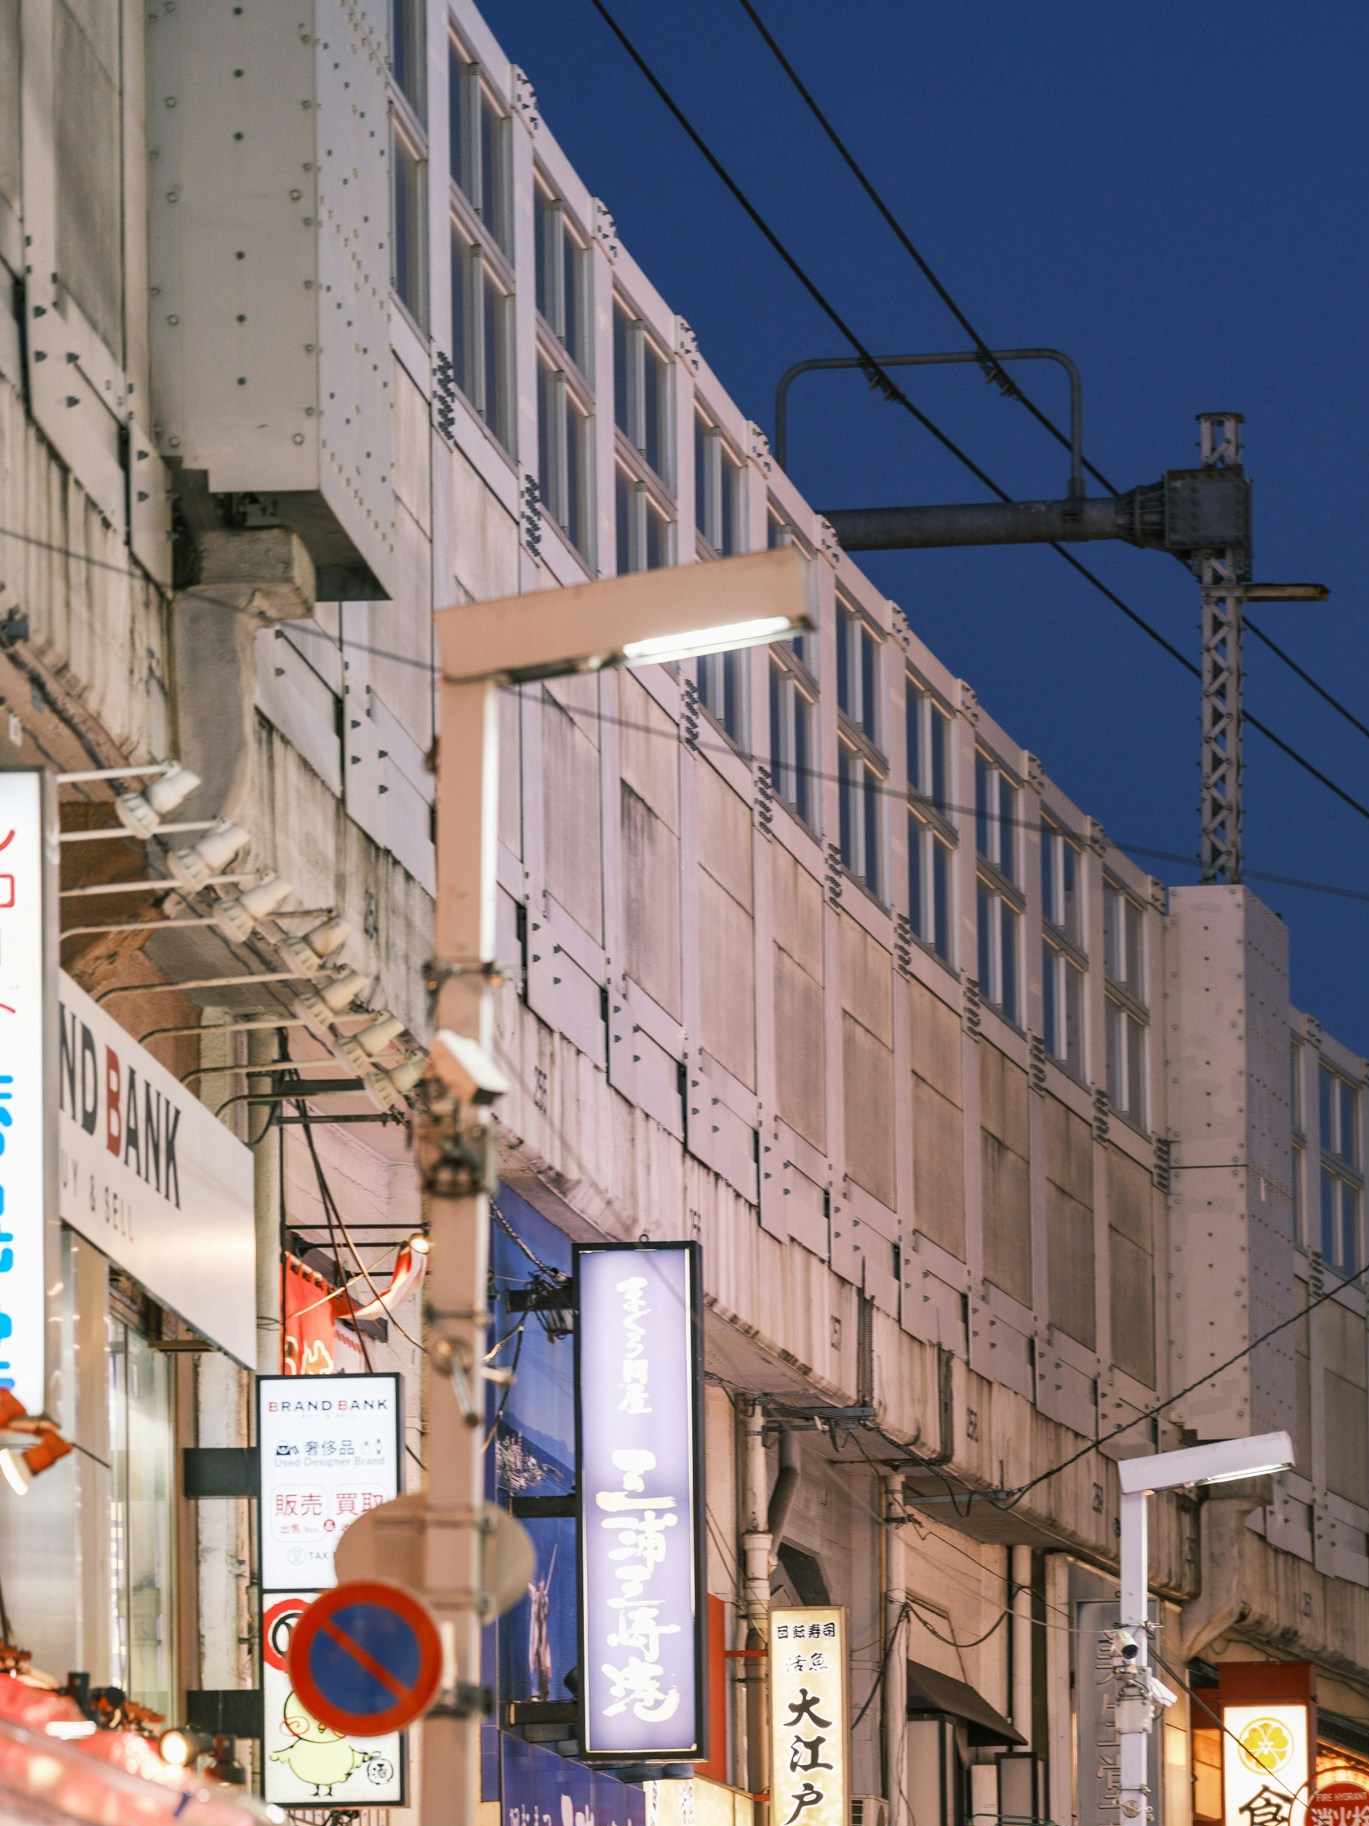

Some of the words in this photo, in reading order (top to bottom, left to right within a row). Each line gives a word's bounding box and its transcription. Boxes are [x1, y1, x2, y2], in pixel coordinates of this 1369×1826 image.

[105, 1044, 181, 1210] BANK
[268, 1401, 333, 1412] BRAND
[338, 1400, 388, 1411] BANK
[304, 1457, 350, 1468] Designer
[355, 1457, 385, 1466] Brand
[275, 1493, 323, 1516] 販売
[336, 1493, 384, 1516] 買取
[783, 1688, 834, 1826] 大江戸
[1316, 1793, 1333, 1802] FIRE
[1334, 1792, 1368, 1801] HYDRANT
